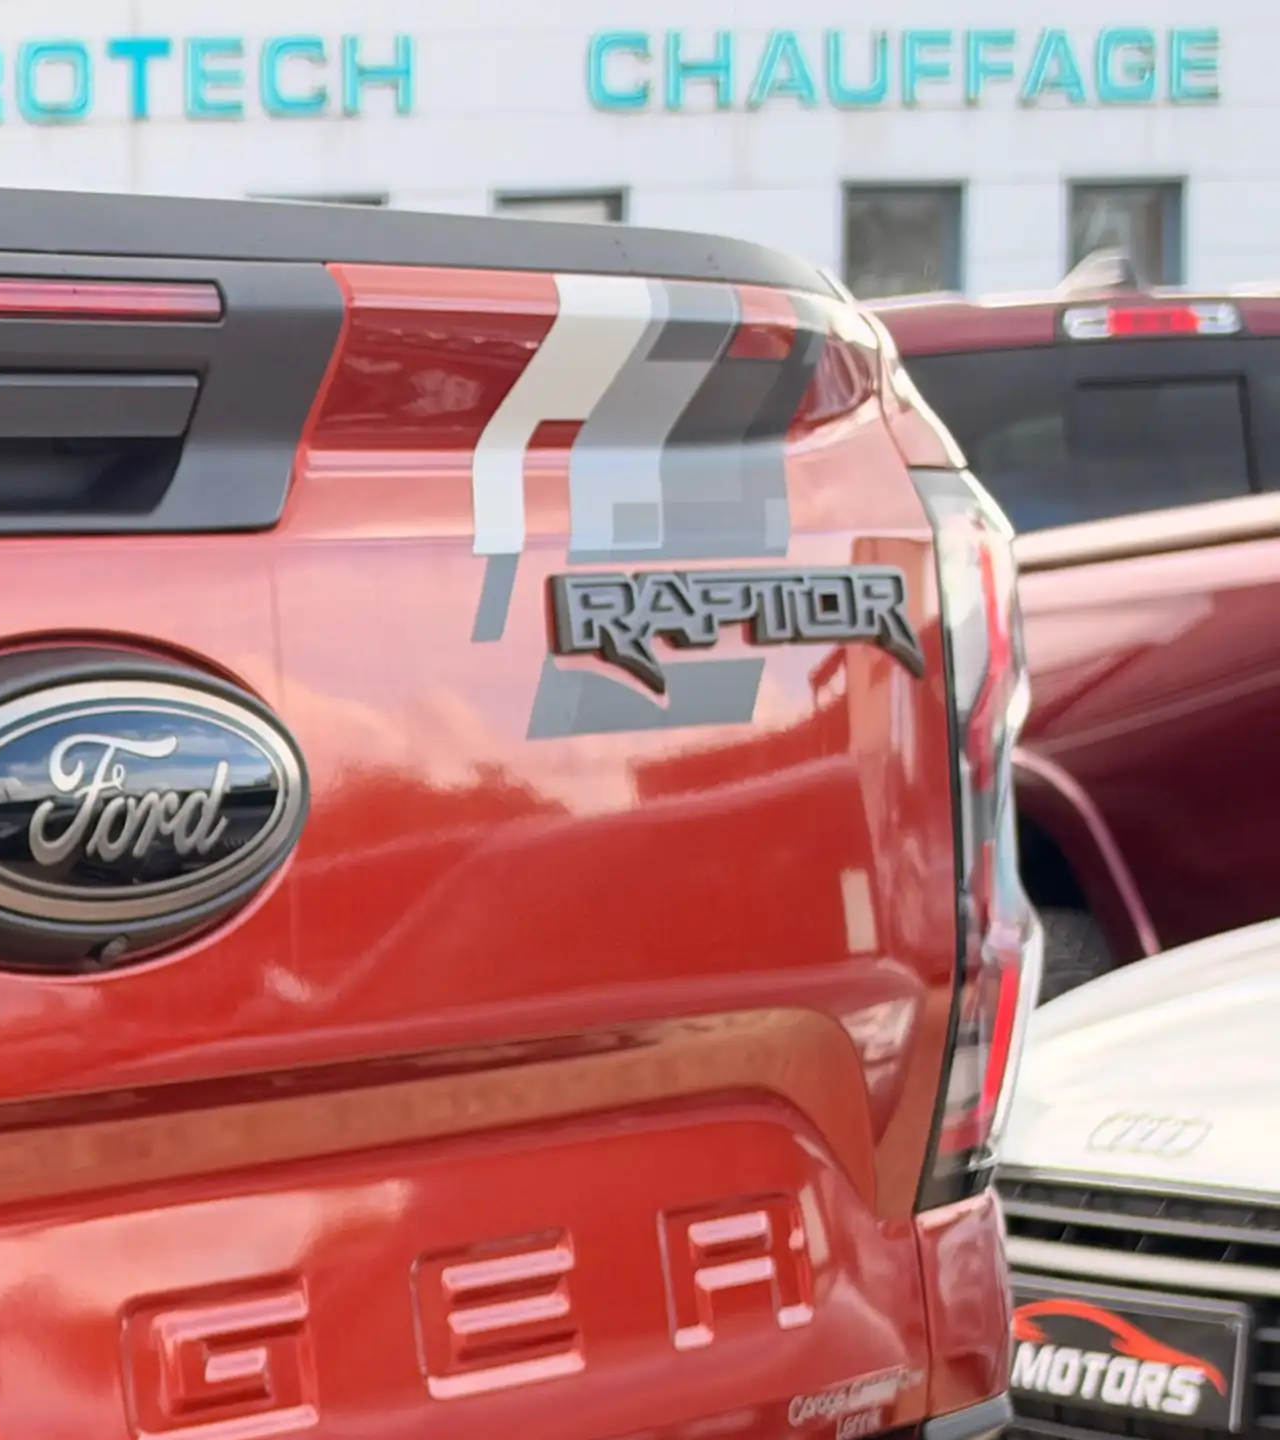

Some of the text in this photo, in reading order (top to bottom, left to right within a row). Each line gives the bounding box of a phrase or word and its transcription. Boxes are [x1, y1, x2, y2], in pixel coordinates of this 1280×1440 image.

[586, 26, 1221, 111] CHAUFFAGE
[547, 566, 924, 694] RAPTOR
[28, 733, 229, 866] Ford
[1010, 1341, 1207, 1416] MOTORS
